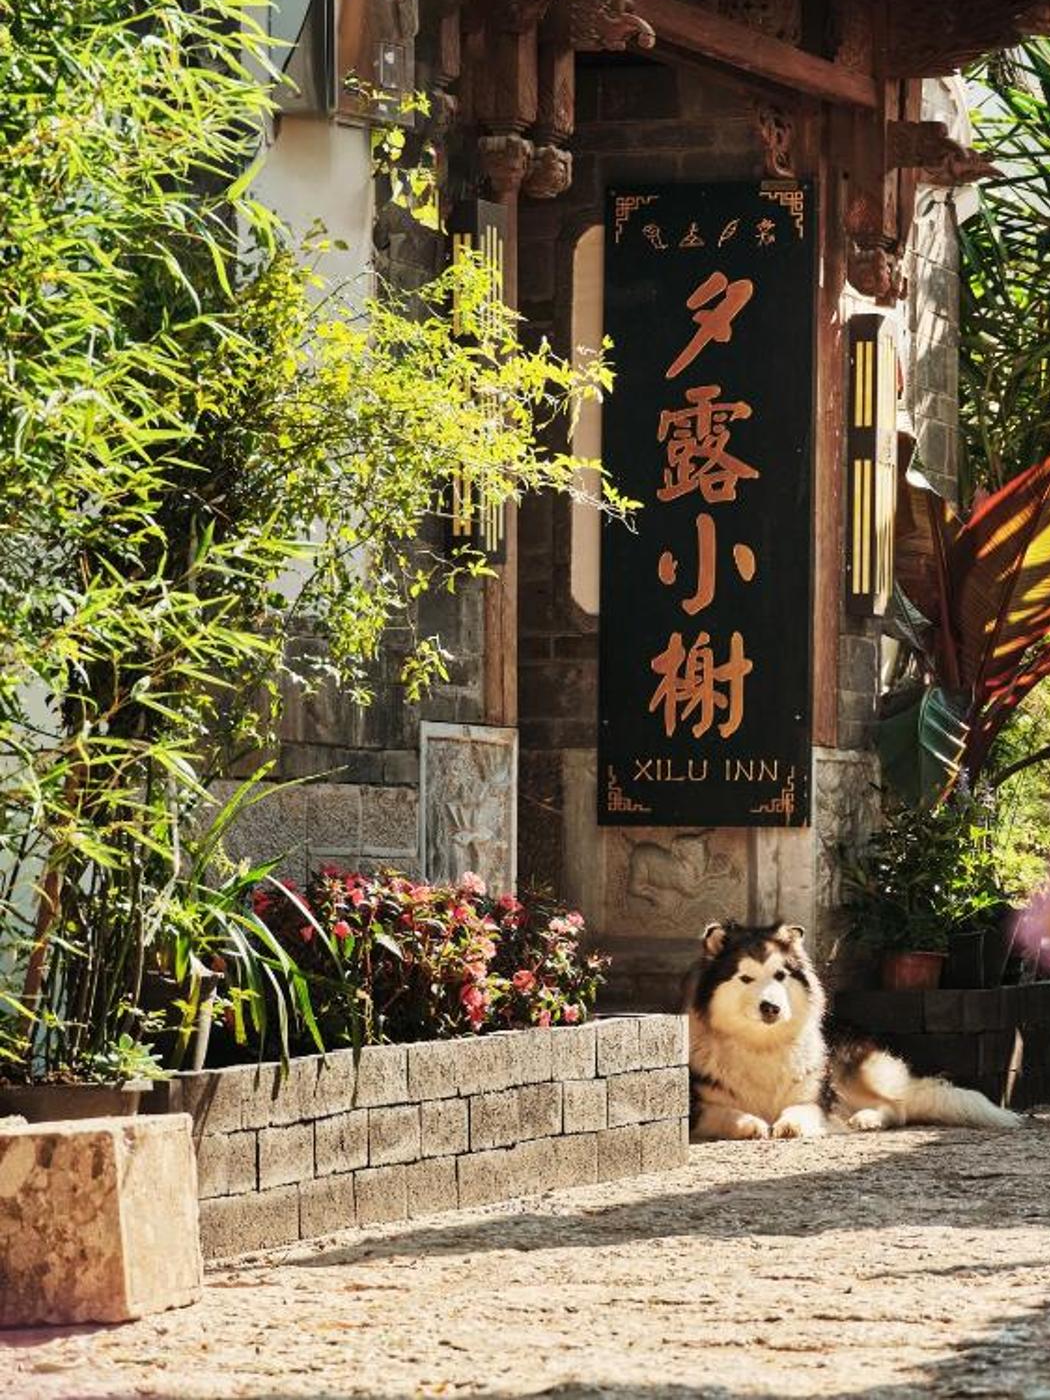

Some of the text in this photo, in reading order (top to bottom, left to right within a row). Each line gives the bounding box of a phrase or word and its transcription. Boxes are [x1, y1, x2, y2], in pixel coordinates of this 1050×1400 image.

[648, 271, 761, 739] 夕露小榭
[633, 758, 779, 782] XILU INN
